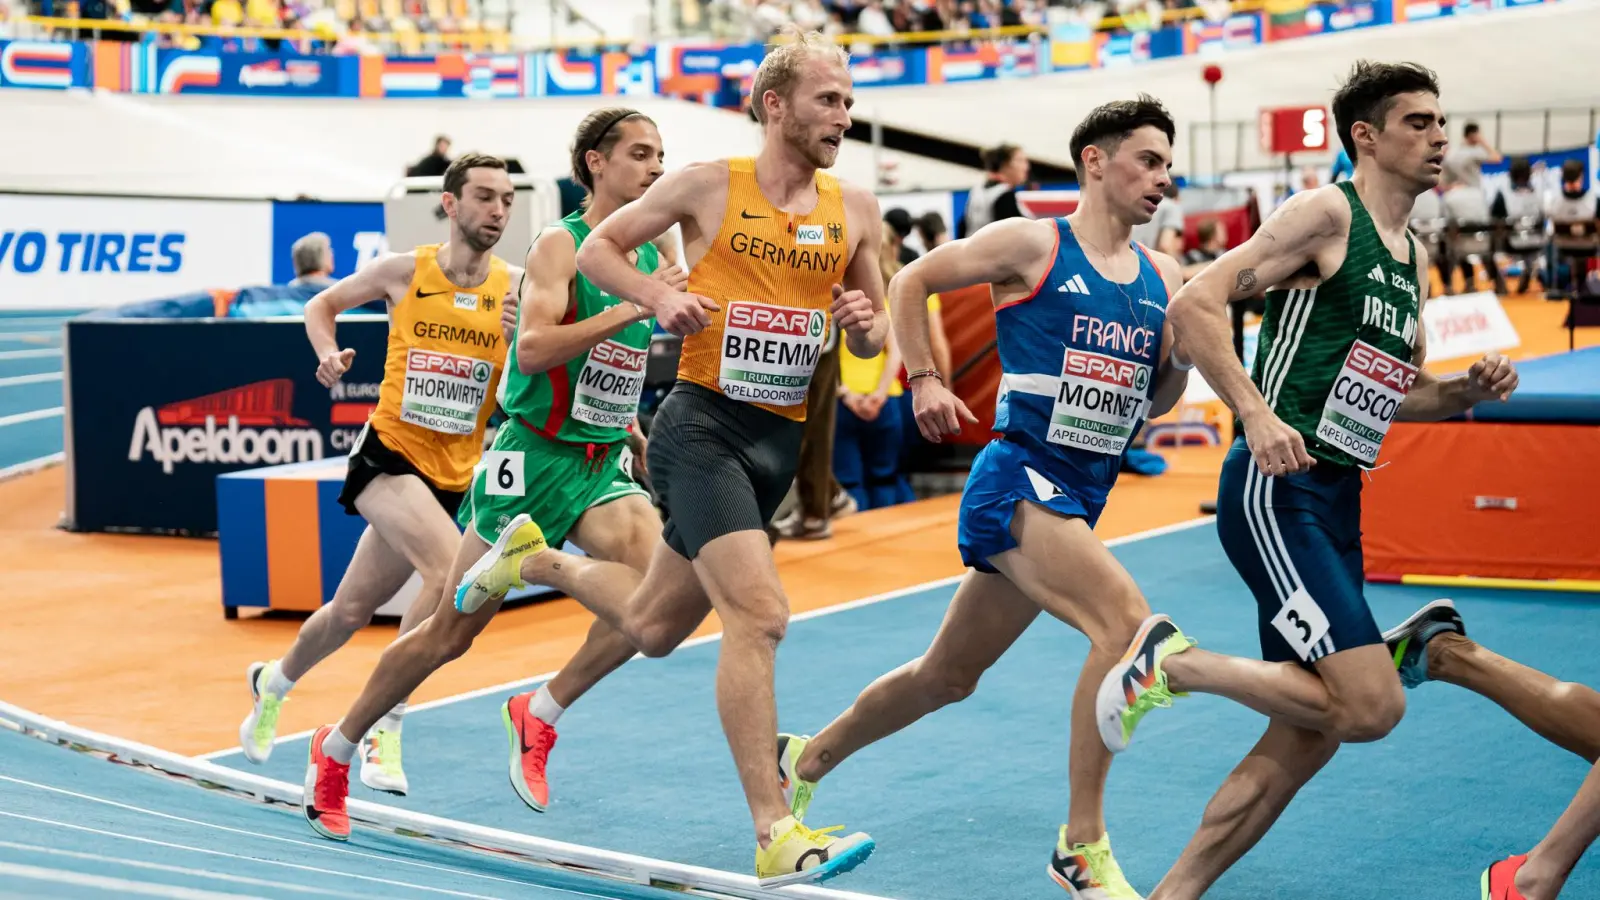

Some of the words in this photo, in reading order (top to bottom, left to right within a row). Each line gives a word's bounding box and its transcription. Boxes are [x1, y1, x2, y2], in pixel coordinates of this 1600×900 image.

[1303, 109, 1324, 147] 5
[797, 230, 822, 240] WGV
[58, 233, 185, 272] TIRES
[730, 232, 841, 273] GERMANY
[454, 296, 476, 306] WGV
[731, 306, 808, 333] SPAR
[413, 321, 500, 349] GERMANY
[1072, 314, 1155, 358] FRANCE
[725, 335, 820, 366] BREMM
[411, 353, 472, 377] SPAR
[743, 372, 747, 381] I
[748, 372, 771, 384] RUN
[772, 375, 800, 386] CLEAN
[1067, 355, 1134, 384] SPAR
[406, 377, 484, 406] THORWIRTH
[593, 400, 610, 409] RUN
[723, 384, 792, 401] APELDOORN
[1058, 381, 1142, 419] MORNET
[404, 411, 459, 430] APELDOORN
[425, 405, 443, 414] RUN
[1080, 419, 1100, 431] RUN
[1346, 420, 1367, 436] RUN
[128, 406, 323, 474] Apeldoorn
[498, 458, 513, 489] 6
[1287, 609, 1311, 643] 3
